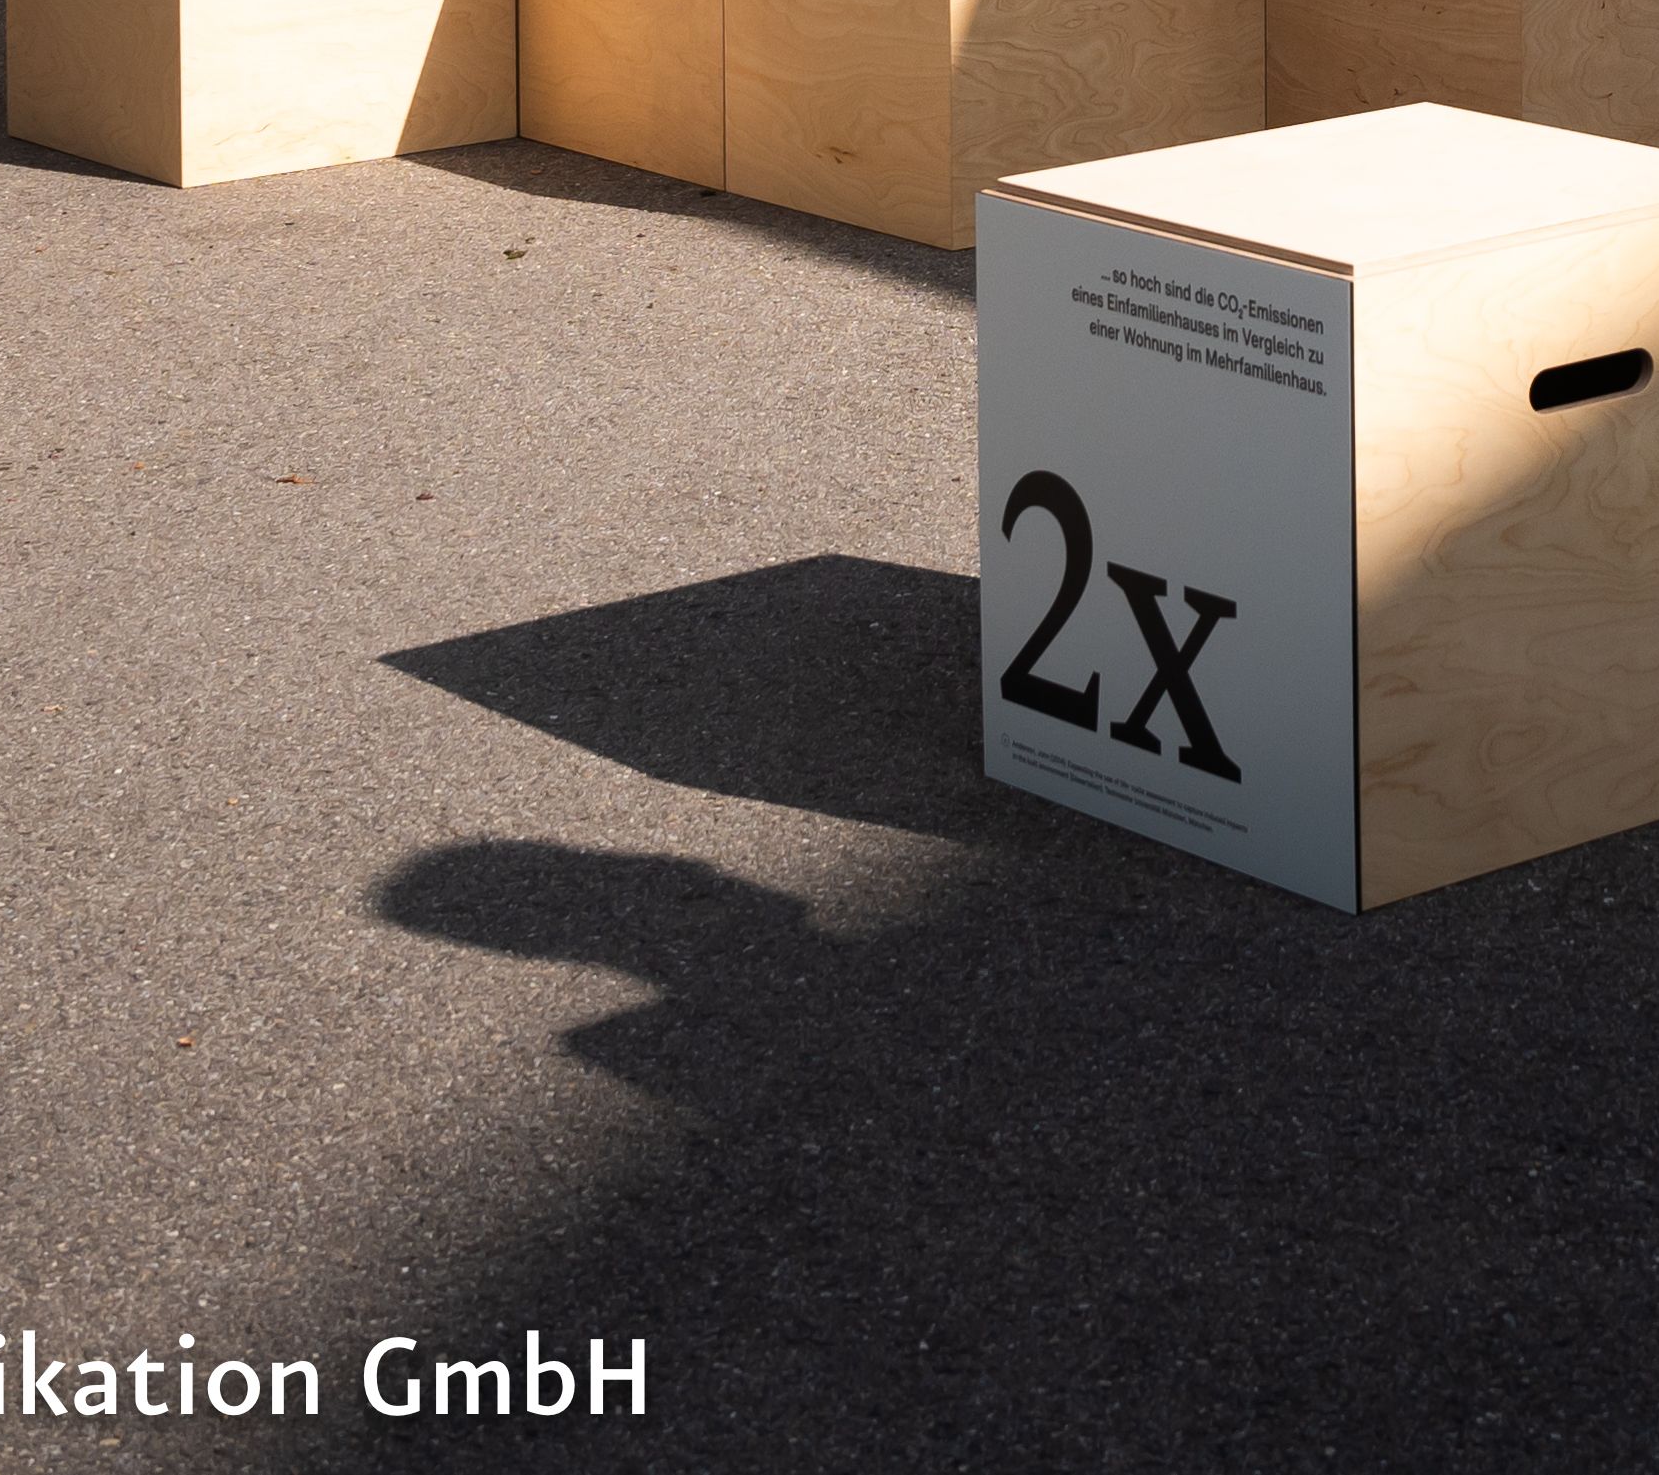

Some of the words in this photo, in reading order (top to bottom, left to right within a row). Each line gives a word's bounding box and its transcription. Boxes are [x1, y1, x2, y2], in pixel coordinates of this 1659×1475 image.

[1071, 285, 1103, 308] eines
[1107, 292, 1219, 338] Einfamilienhauses
[1223, 322, 1238, 342] im
[1242, 327, 1303, 360] Vergleich
[1308, 348, 1323, 364] zu
[1112, 269, 1126, 285] so
[1130, 269, 1160, 293] hoch
[1165, 279, 1190, 301] sind
[1194, 287, 1214, 307] die
[1089, 318, 1119, 340] einer
[1123, 325, 1182, 362] Wohnung
[1186, 342, 1201, 362] im
[1205, 347, 1326, 396] Mehrfamilienhaus.
[1001, 470, 1242, 784] 2x
